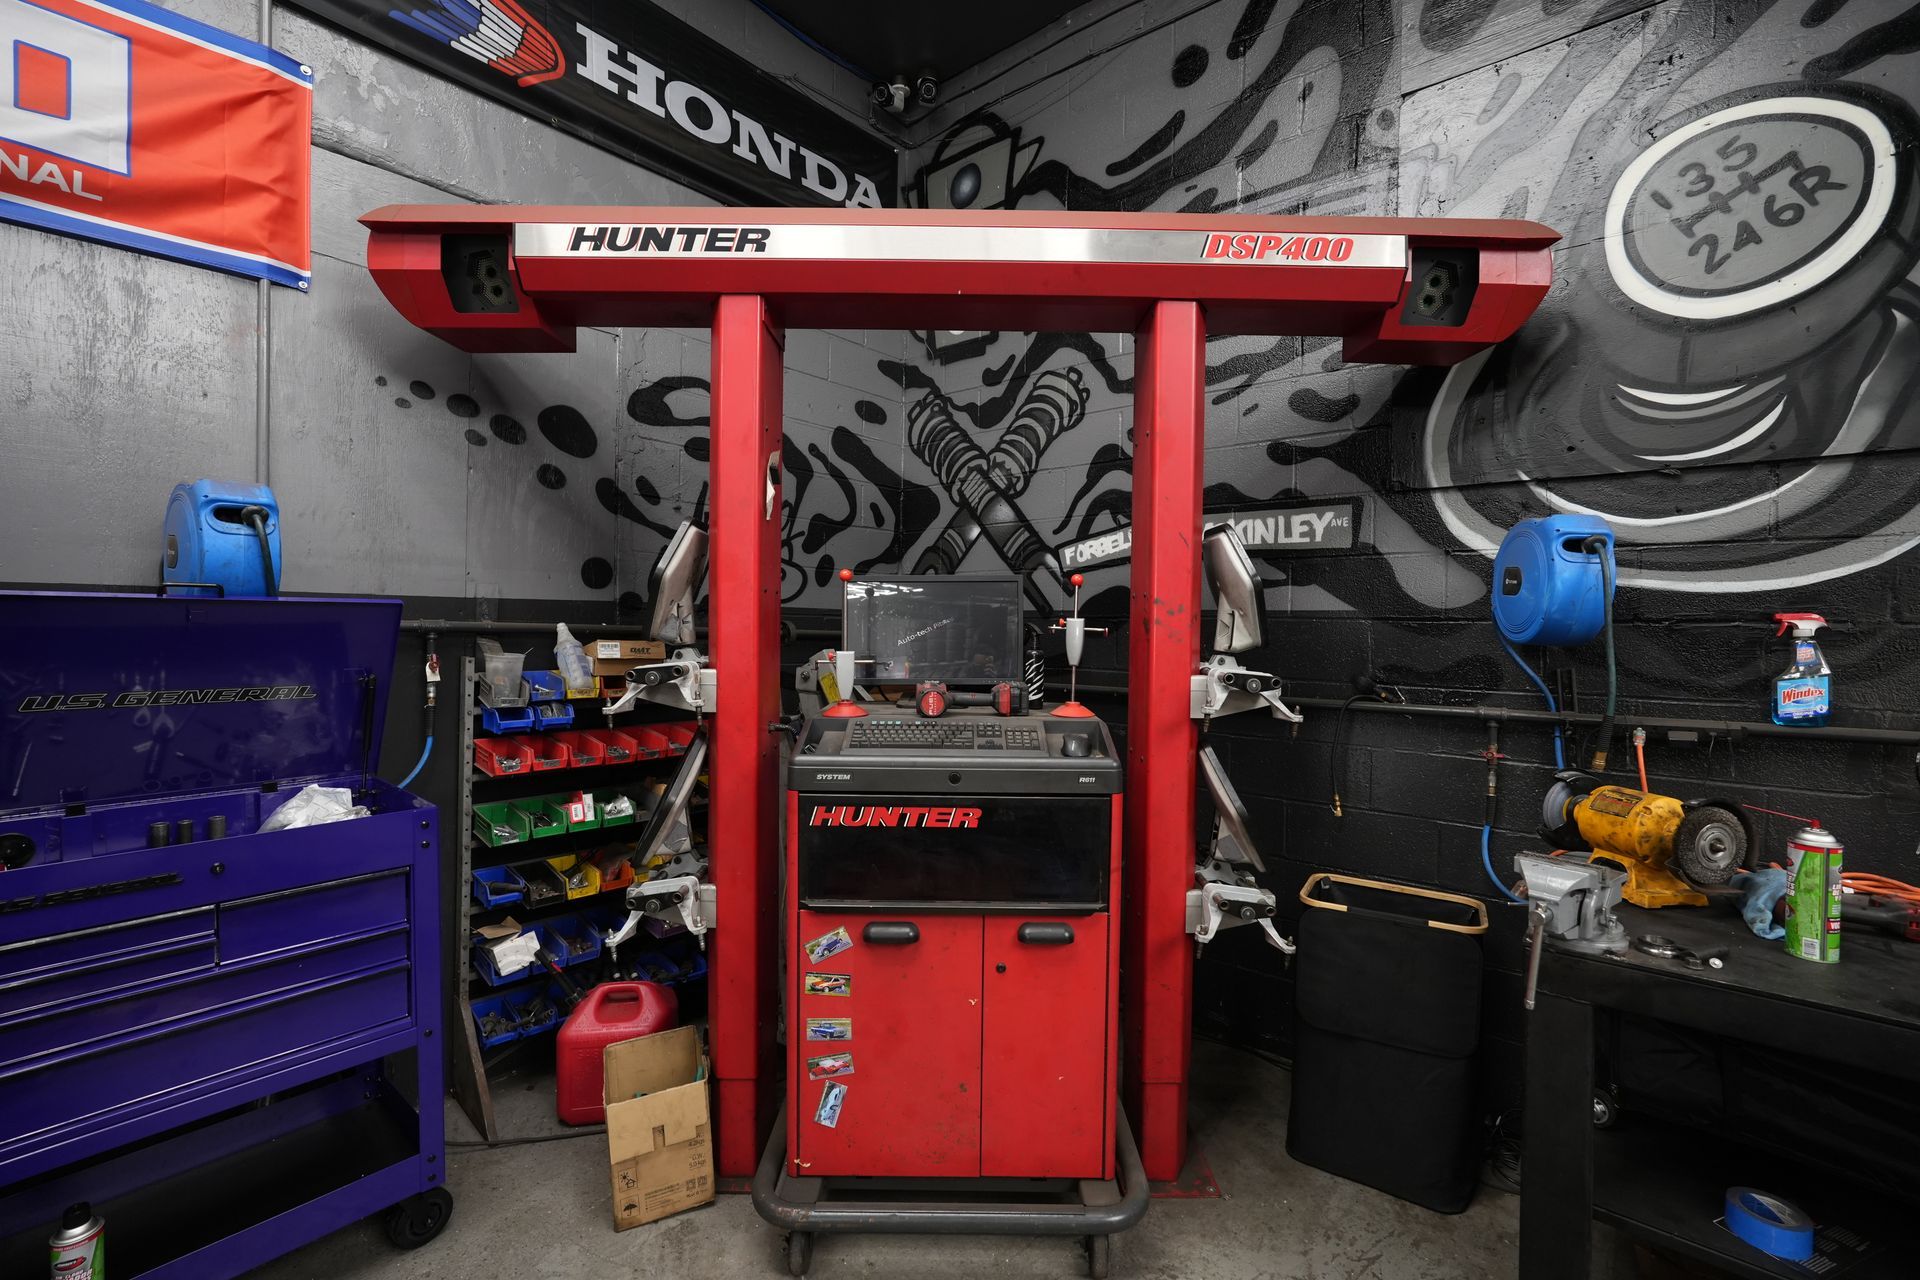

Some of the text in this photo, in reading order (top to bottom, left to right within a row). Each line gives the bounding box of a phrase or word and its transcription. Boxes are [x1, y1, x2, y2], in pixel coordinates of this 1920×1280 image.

[576, 21, 883, 208] HONDA
[567, 227, 771, 253] HUNTER
[1202, 232, 1354, 262] DSP400
[1064, 528, 1132, 566] FORBEL
[1330, 516, 1349, 528] AVE
[17, 684, 318, 713] U.S. GENERAL
[1782, 687, 1825, 705] Windex
[816, 773, 851, 781] SYSTEM
[809, 805, 982, 828] HUNTER
